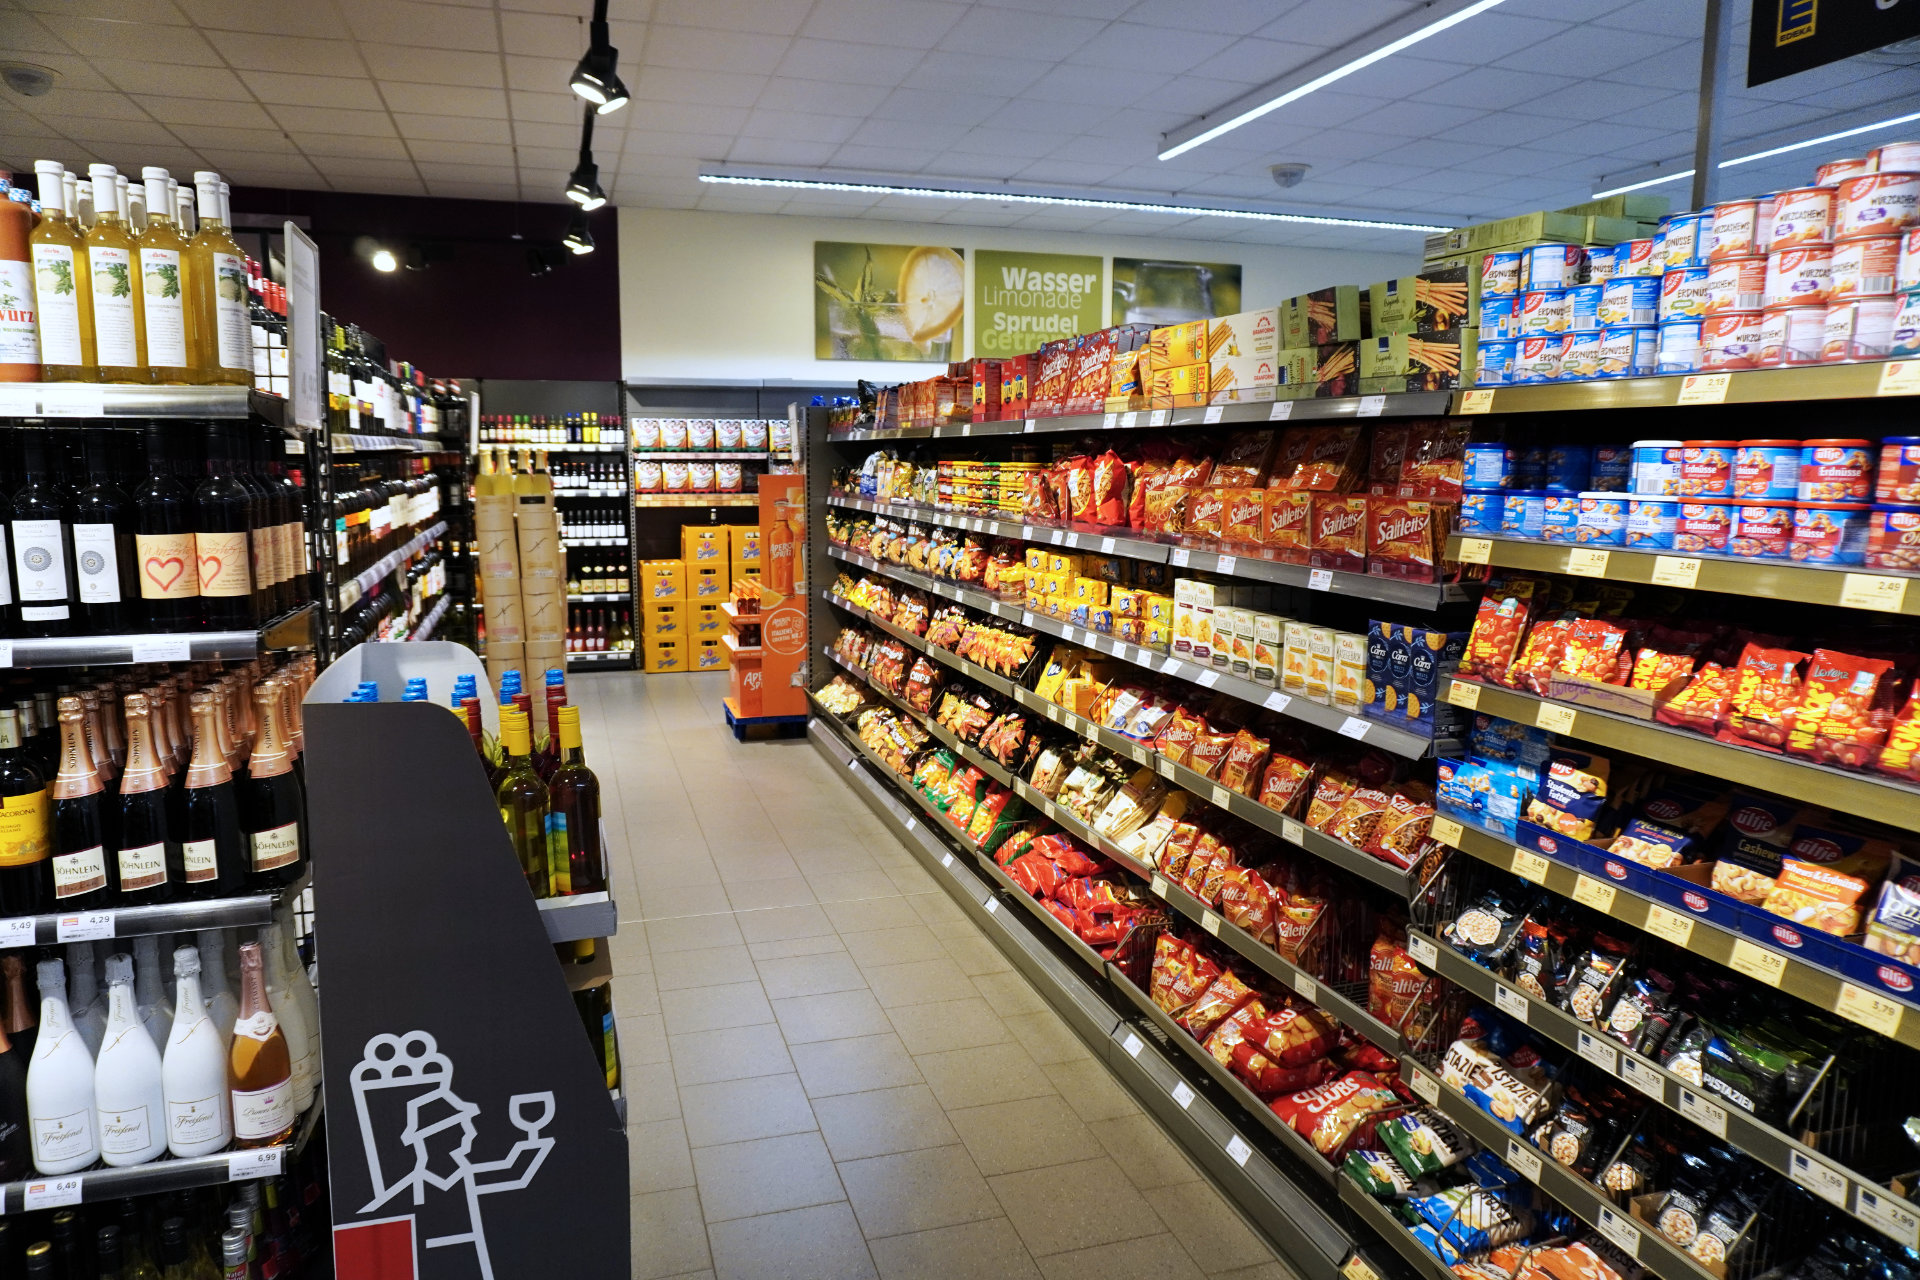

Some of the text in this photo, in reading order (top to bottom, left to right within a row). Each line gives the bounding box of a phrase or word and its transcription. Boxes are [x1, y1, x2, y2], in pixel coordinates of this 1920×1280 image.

[1779, 25, 1813, 42] EDEKA
[1001, 267, 1097, 294] Wasser
[984, 285, 1082, 309] Limonade
[993, 312, 1078, 335] Sprudel
[1900, 314, 1920, 327] CASH
[1196, 322, 1204, 350] BIO
[1198, 365, 1206, 393] BIO
[1815, 448, 1841, 460] ültje
[1684, 466, 1717, 474] Erdnüsse
[1817, 466, 1862, 477] Erdnüsse
[1229, 503, 1264, 527] Saltletts
[1270, 502, 1307, 533] Saltletts
[1684, 504, 1704, 516] ültje
[1743, 507, 1765, 519] ültje
[1319, 510, 1363, 540] Saltletts
[1581, 514, 1609, 524] Erdnüsse
[1685, 521, 1721, 531] Erdnüsse
[1893, 515, 1920, 528] ültje
[1376, 515, 1427, 545] Saltletts
[1742, 524, 1782, 535] Erdnüsse
[1679, 562, 1696, 571] 2,49
[1878, 581, 1901, 591] 2,49
[771, 627, 793, 637] ITALIENS
[1475, 646, 1499, 654] CRUNCH
[1746, 655, 1778, 671] Lorenz
[743, 671, 763, 686] APE
[909, 671, 930, 685] CHIPS
[1814, 665, 1849, 680] Lorenz
[263, 714, 273, 749] SÖHNLEIN
[1167, 727, 1195, 741] Saltletts
[1821, 726, 1857, 736] CRUNCH
[67, 732, 77, 769] SÖHNLEIN
[132, 729, 141, 765] SÖHNLEIN
[1546, 779, 1581, 800] Studenten
[1548, 790, 1572, 804] Futter
[1647, 802, 1681, 818] ültje
[1736, 810, 1773, 831] ültje
[253, 839, 296, 851] SÖHNLEIN
[1539, 836, 1557, 851] ültje
[1737, 838, 1782, 862] Cashews
[1797, 840, 1836, 861] ültje
[55, 863, 101, 876] SÖHNLEIN
[119, 858, 162, 870] SÖHNLEIN
[1532, 858, 1546, 869] 3,49
[1606, 862, 1625, 876] ültje
[1787, 873, 1808, 888] Honig
[1823, 883, 1840, 895] Salz
[1819, 869, 1865, 892] Erdnüsse
[1597, 886, 1611, 898] 3,79
[1683, 893, 1706, 908] ültje
[11, 921, 31, 930] 5,49
[90, 915, 111, 925] 4,29
[1672, 917, 1689, 930] 3,79
[1774, 926, 1800, 944] ültje
[1761, 954, 1782, 968] 3,79
[1879, 968, 1910, 986] ültje
[1872, 1000, 1895, 1016] 3,79
[1645, 1070, 1661, 1084] 1,79
[1703, 1072, 1756, 1113] PISTAZIEN
[1705, 1105, 1723, 1120] 3,19
[1560, 1115, 1590, 1134] CASHEW
[257, 1153, 277, 1163] 6,99
[56, 1181, 77, 1191] 6,49
[1821, 1171, 1843, 1189] 1,59
[1891, 1208, 1915, 1229] 2,99
